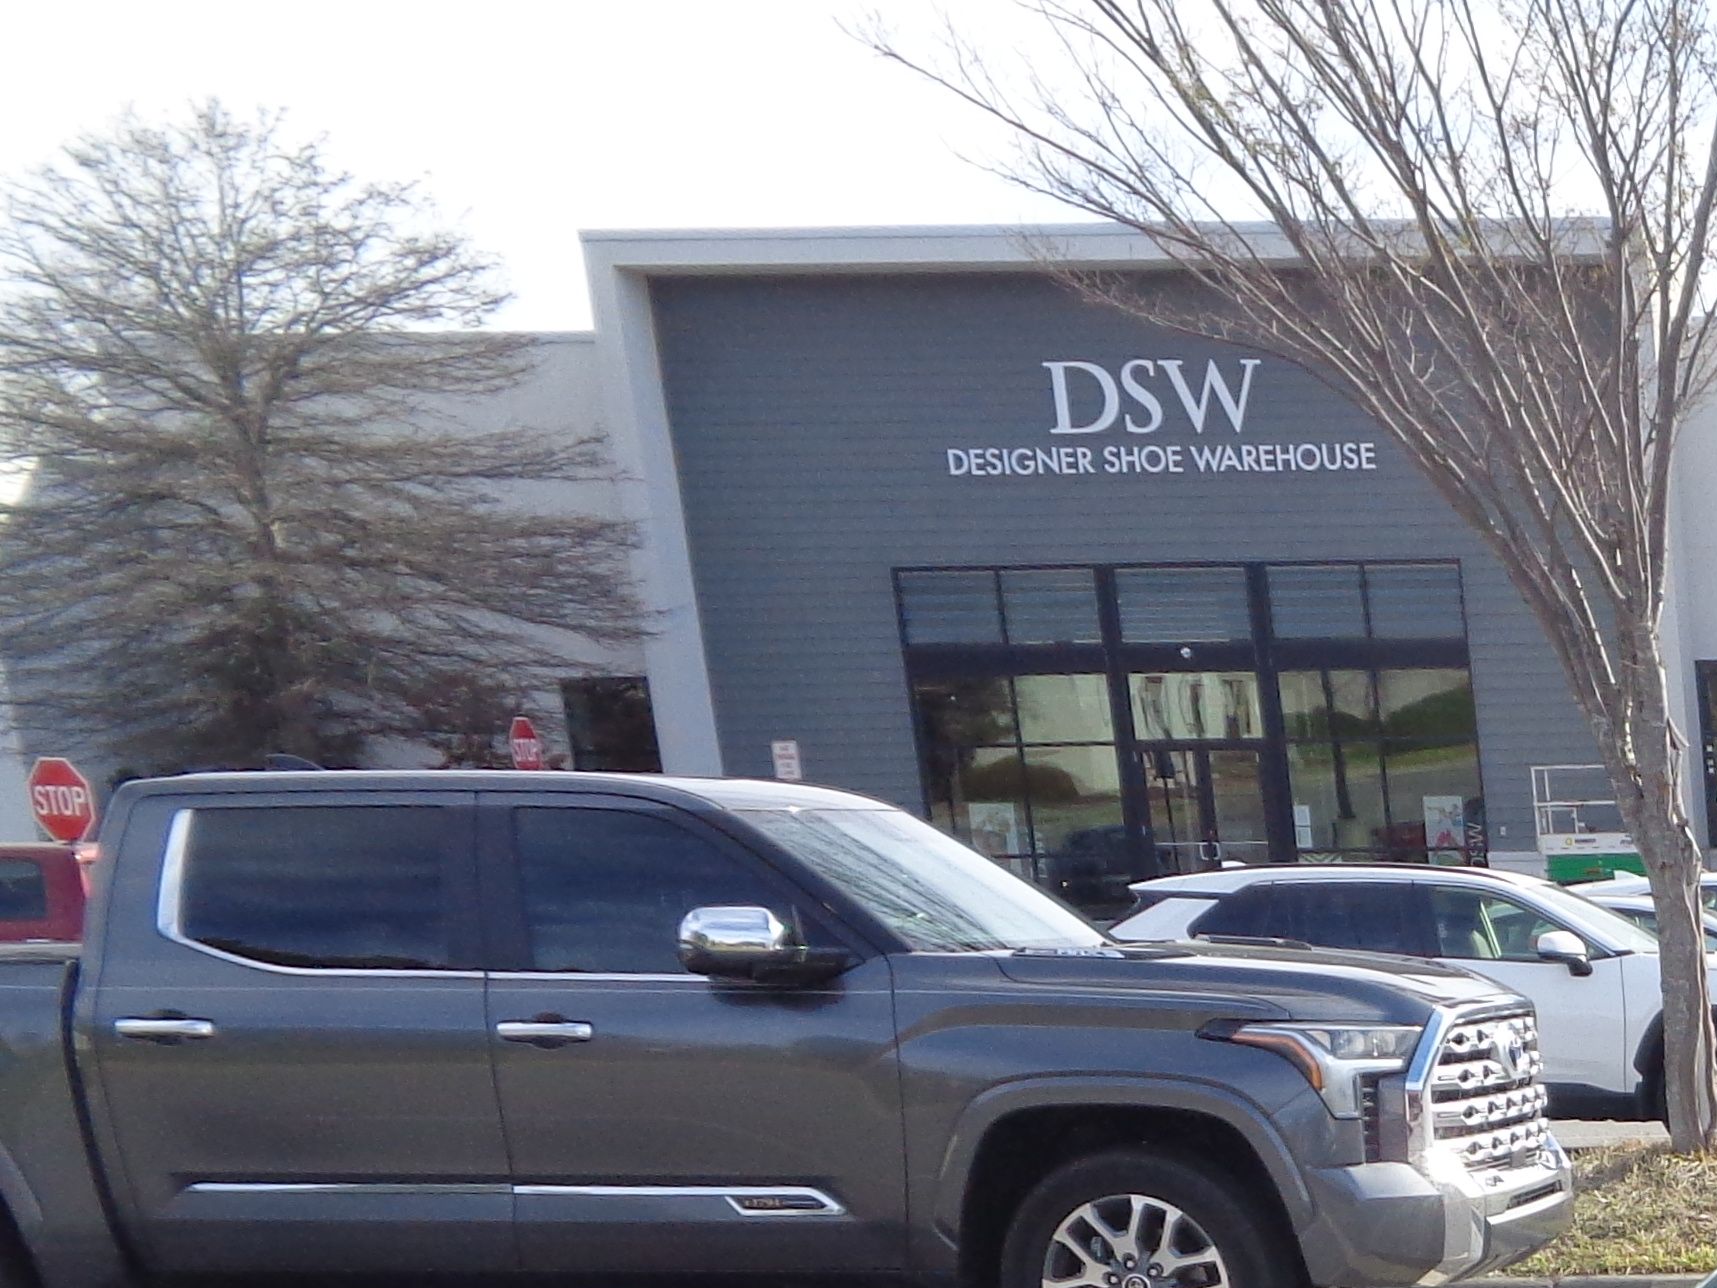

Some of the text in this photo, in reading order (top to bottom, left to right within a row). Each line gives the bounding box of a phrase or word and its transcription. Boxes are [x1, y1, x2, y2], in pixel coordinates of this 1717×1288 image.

[1041, 358, 1261, 434] DSW
[947, 442, 1376, 475] DESIGNER SHOE WAREHOUSE
[513, 738, 538, 762] STOP
[34, 784, 85, 816] STOP
